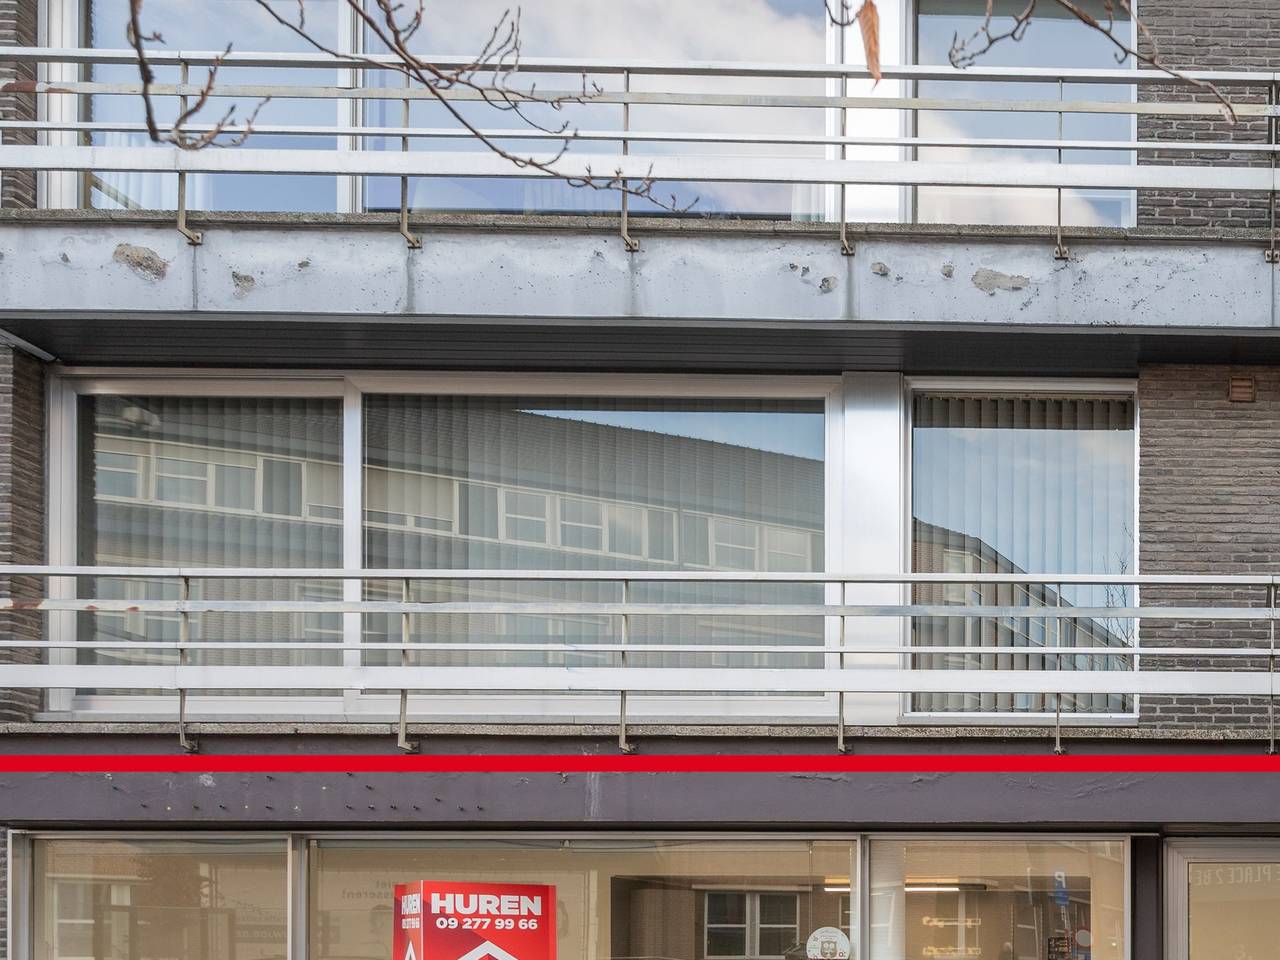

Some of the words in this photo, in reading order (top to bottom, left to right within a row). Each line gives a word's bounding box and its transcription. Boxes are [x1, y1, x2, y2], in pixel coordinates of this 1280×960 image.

[431, 893, 542, 916] HUREN
[436, 917, 459, 929] 09
[462, 918, 491, 930] 277
[495, 918, 515, 930] 99
[518, 918, 538, 930] 66
